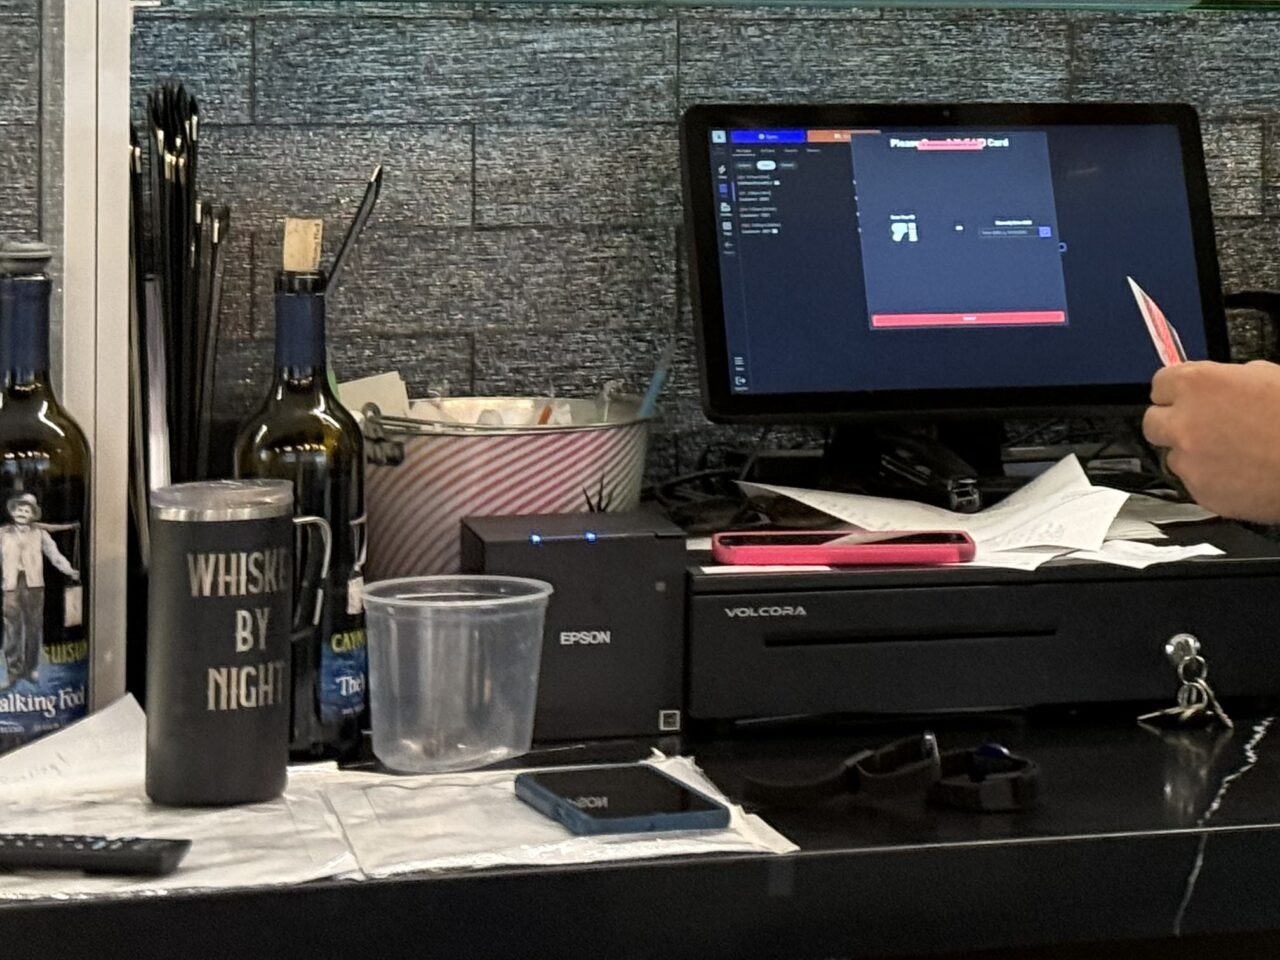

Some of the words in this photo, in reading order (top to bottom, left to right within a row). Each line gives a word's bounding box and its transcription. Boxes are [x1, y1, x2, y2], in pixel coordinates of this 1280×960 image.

[724, 606, 808, 618] VOLCORA
[235, 608, 270, 652] BY
[560, 630, 611, 646] EPSON
[207, 660, 286, 710] NIGHT
[0, 692, 57, 718] alking
